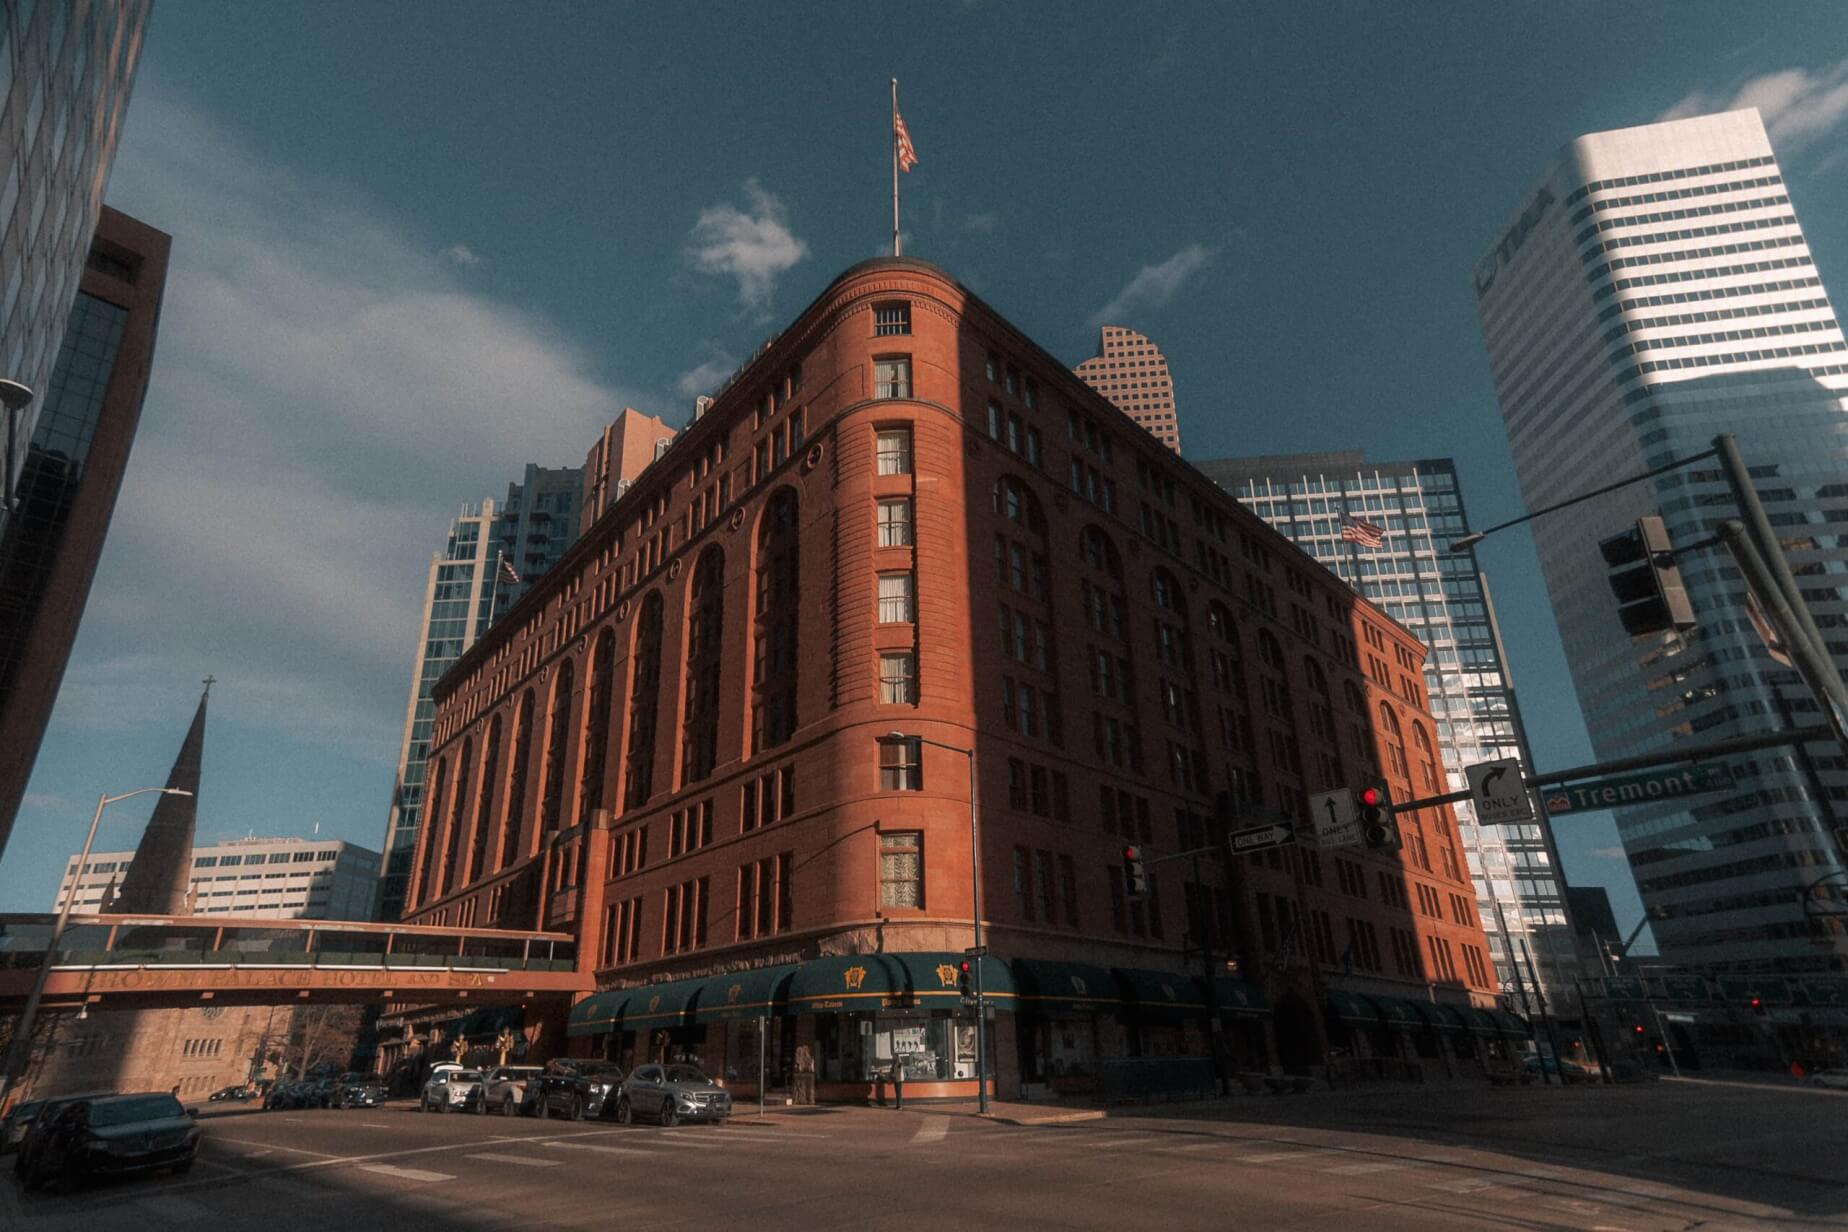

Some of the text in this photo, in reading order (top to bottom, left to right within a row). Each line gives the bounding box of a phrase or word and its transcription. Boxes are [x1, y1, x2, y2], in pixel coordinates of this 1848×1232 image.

[1573, 771, 1697, 808] Tremont
[1482, 795, 1518, 810] ONLY
[209, 970, 312, 987] PALACE
[323, 971, 398, 987] HOTEL
